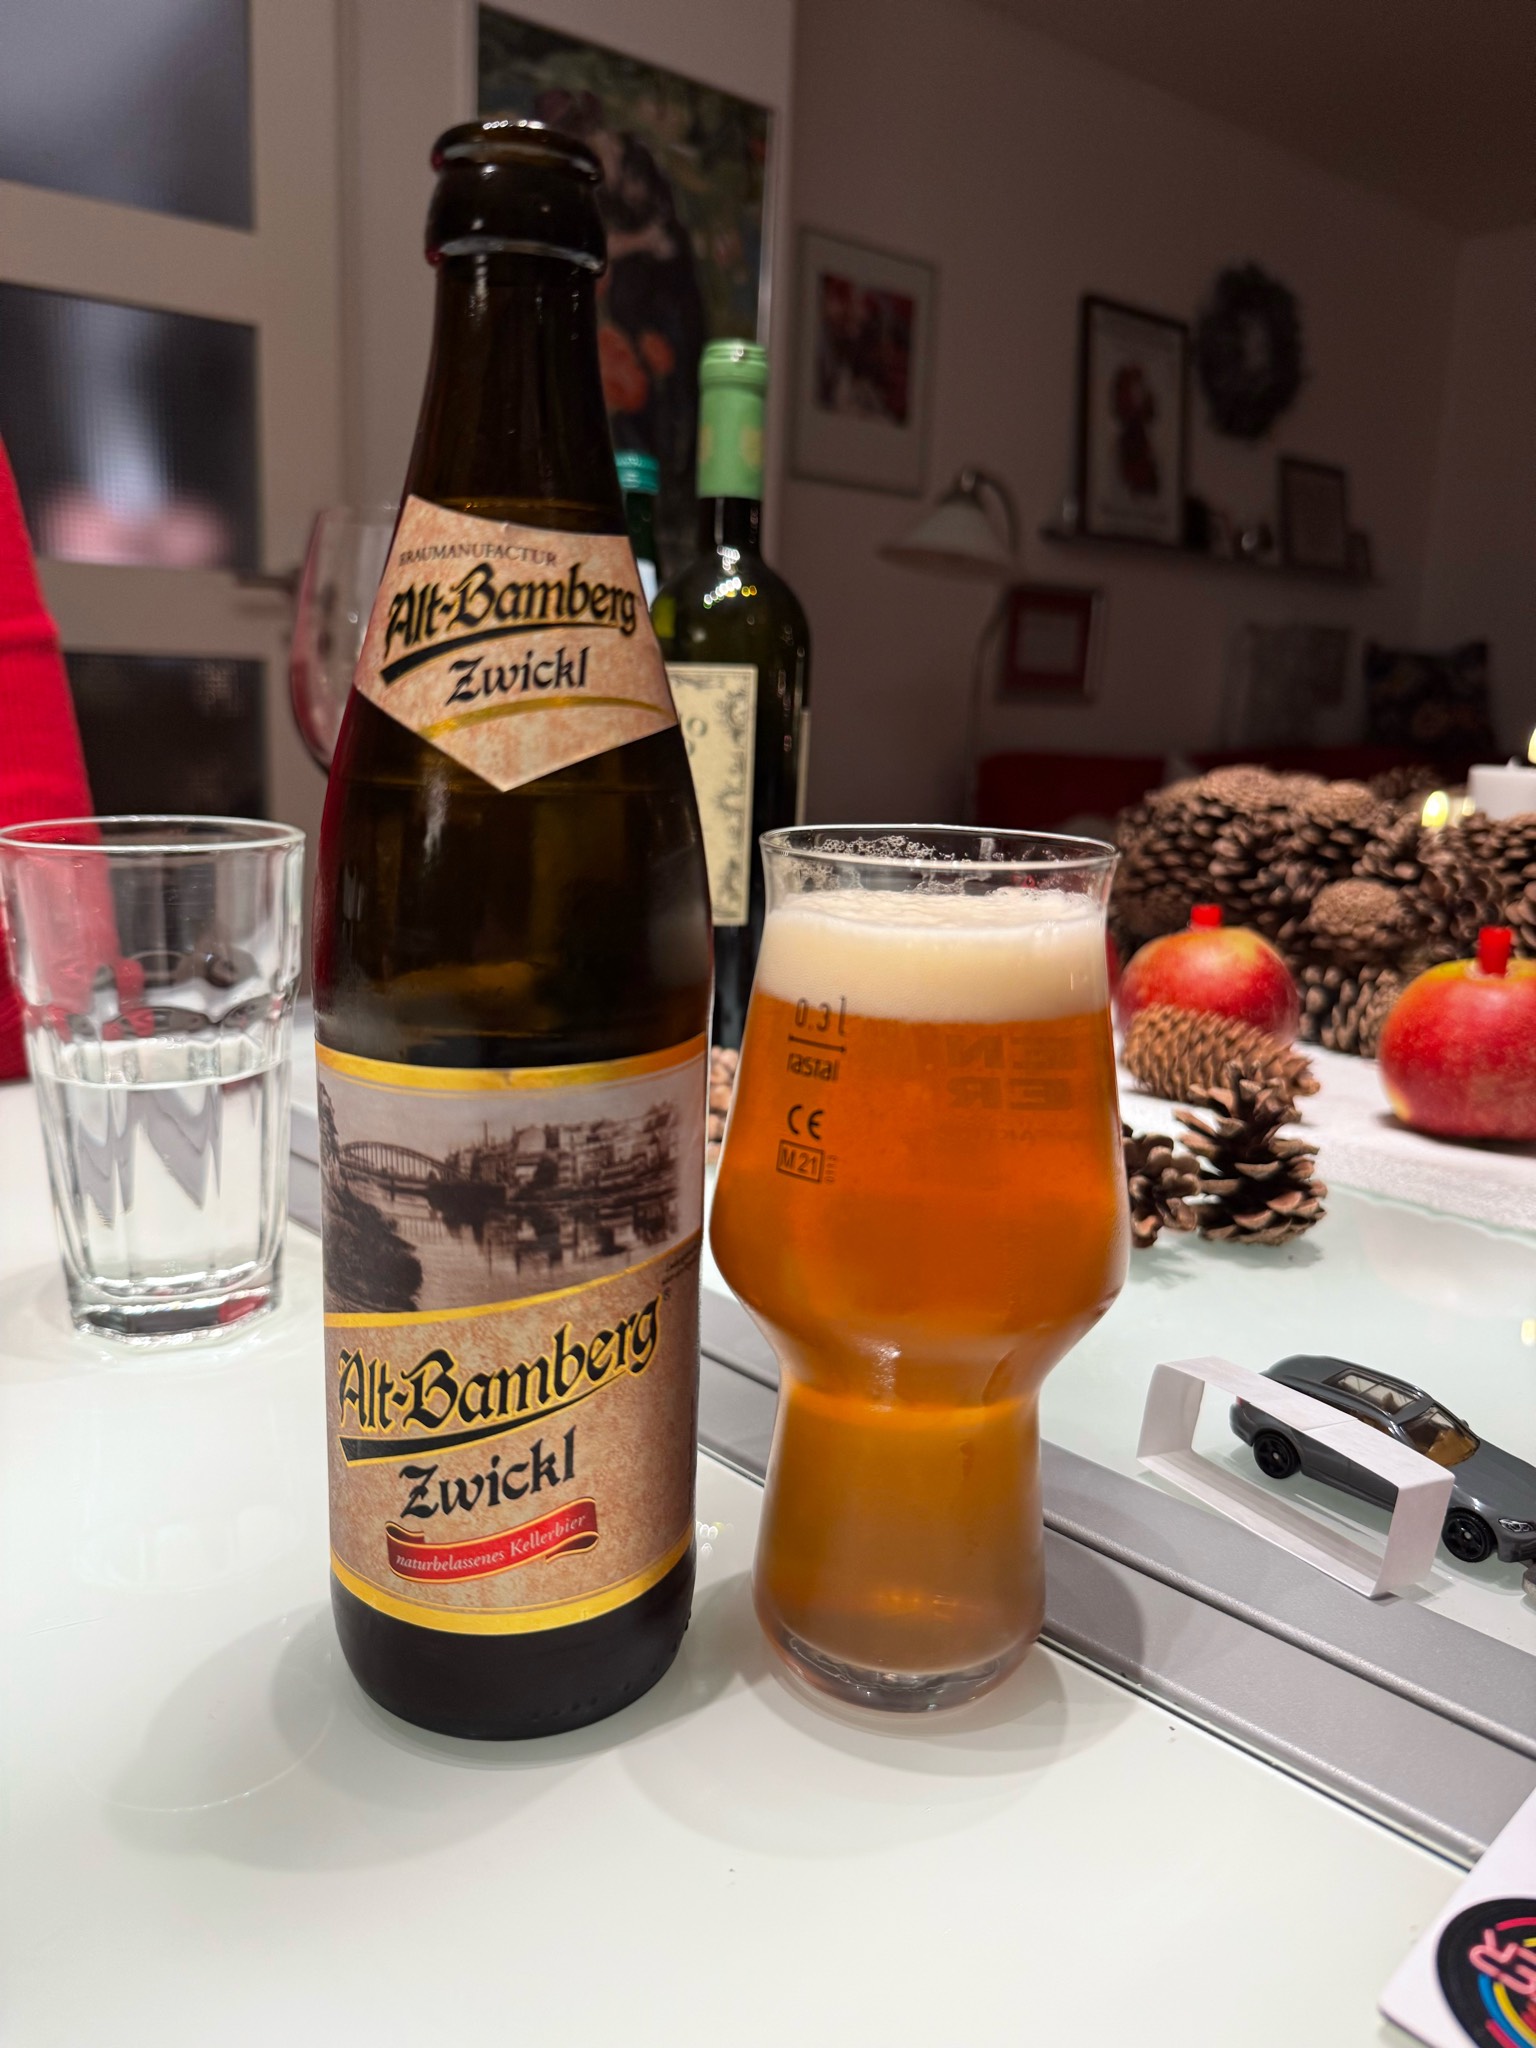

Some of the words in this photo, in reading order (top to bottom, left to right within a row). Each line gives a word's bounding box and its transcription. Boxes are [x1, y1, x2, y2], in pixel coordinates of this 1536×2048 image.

[399, 543, 557, 567] BRAUMANUFACTUR
[384, 561, 637, 660] Alt-Bamberg
[445, 645, 590, 706] Zwickl
[338, 1293, 663, 1433] Alt-Bamberg
[399, 1423, 577, 1520] Zwickl
[395, 1548, 505, 1573] naturbelassenes
[510, 1512, 587, 1557] Kellerbier
